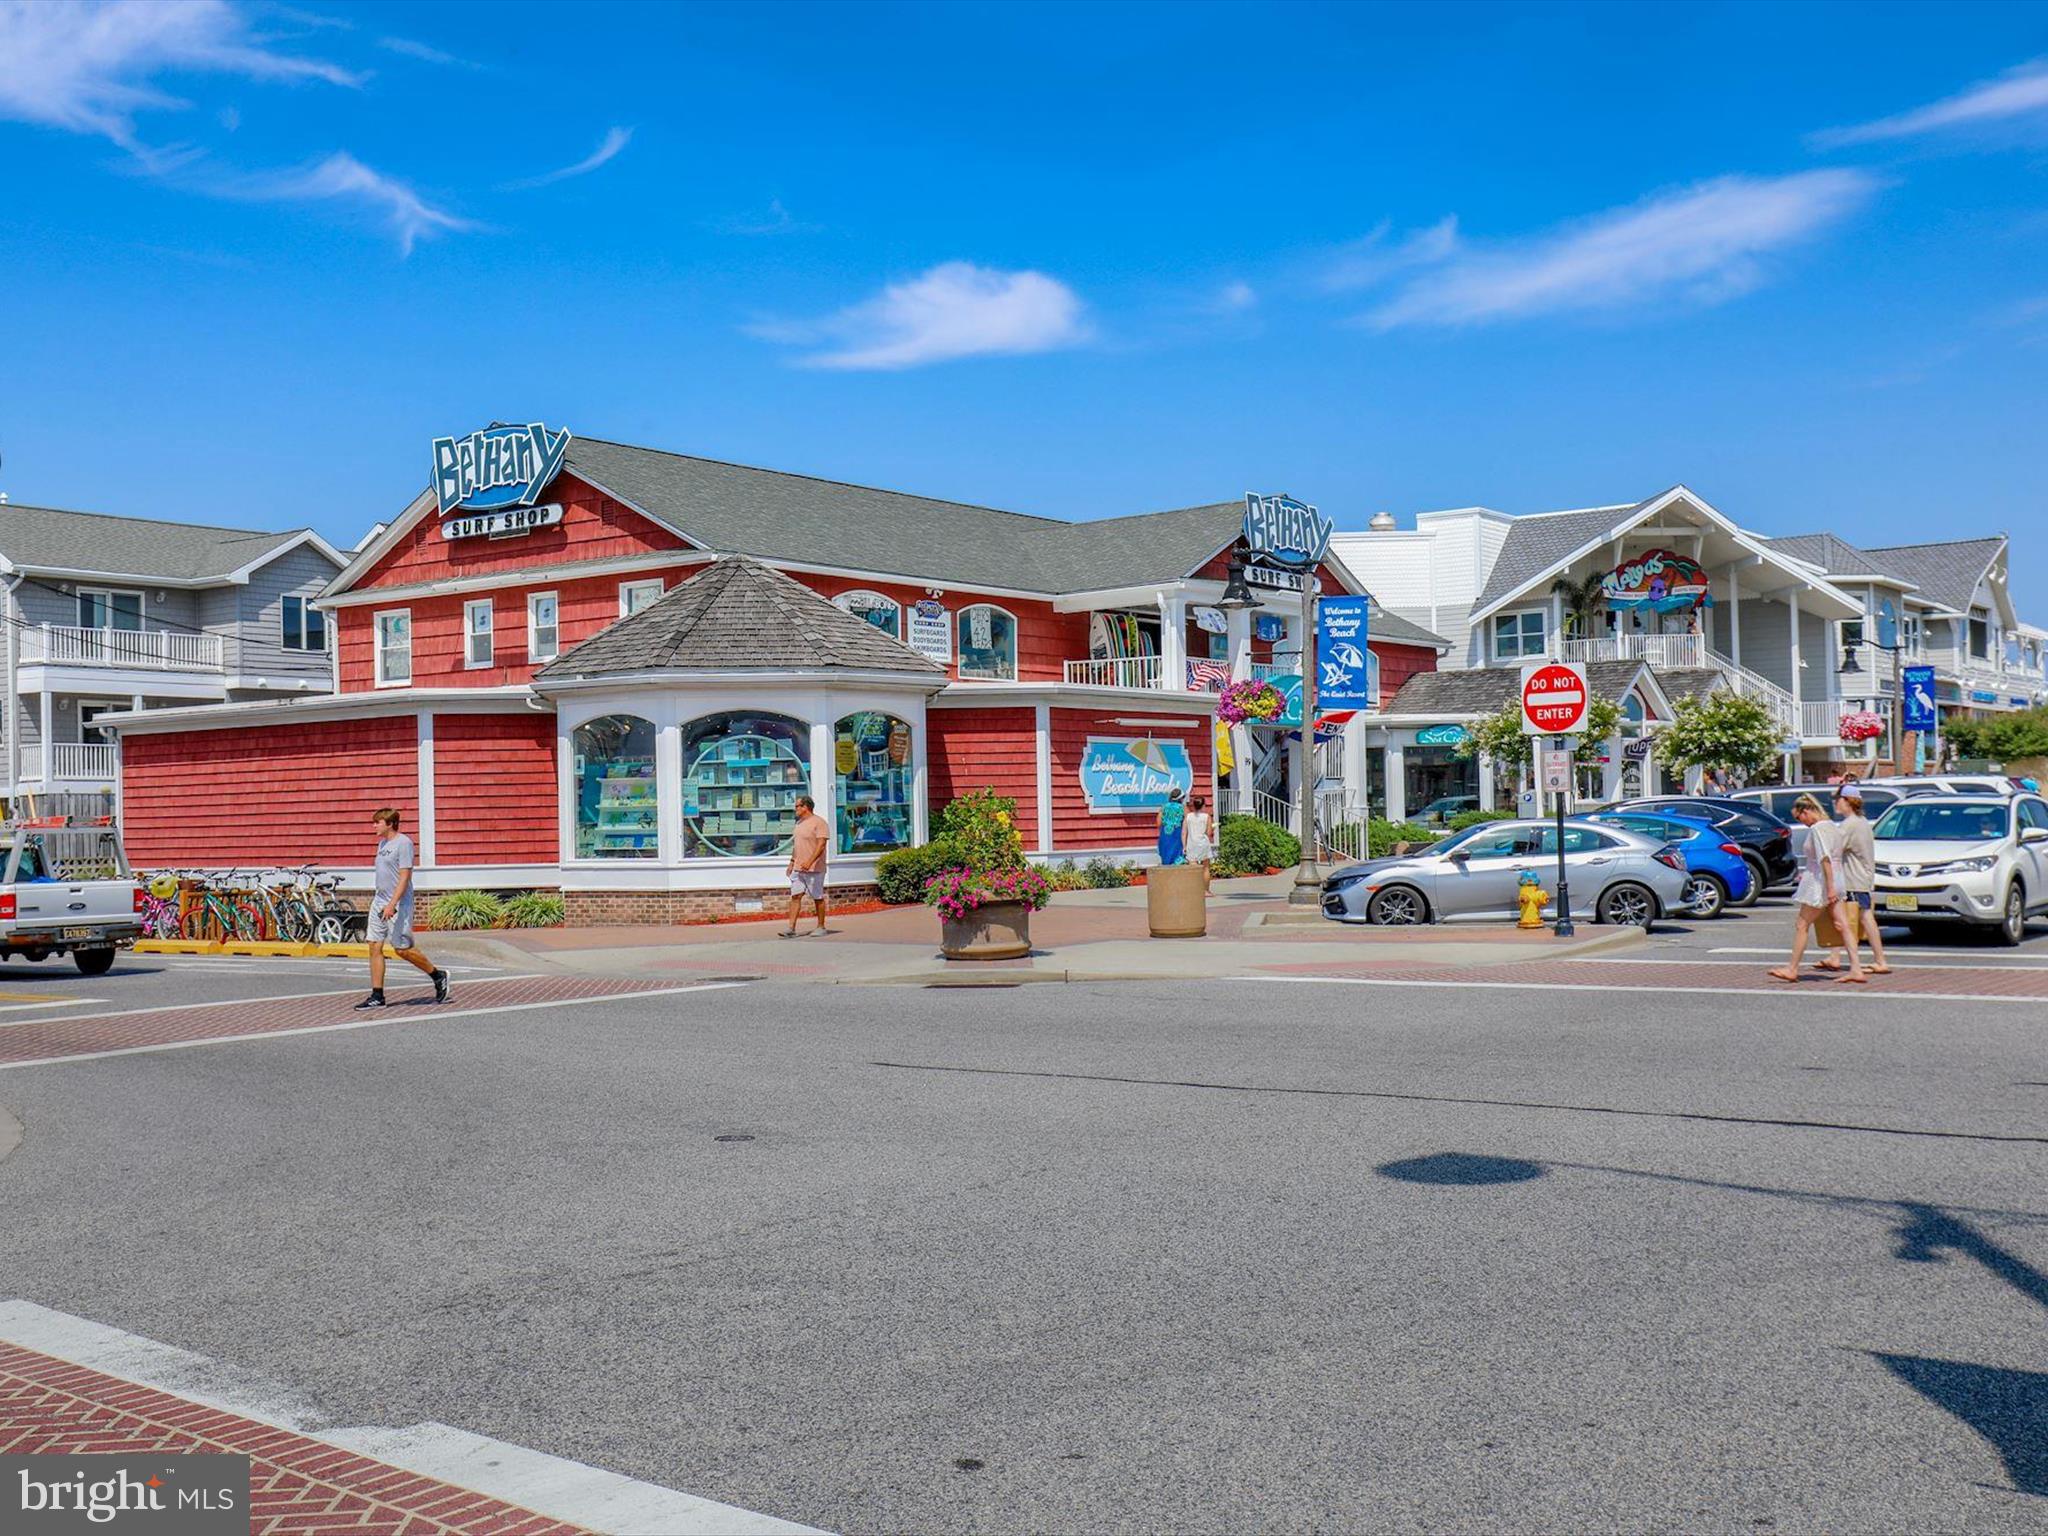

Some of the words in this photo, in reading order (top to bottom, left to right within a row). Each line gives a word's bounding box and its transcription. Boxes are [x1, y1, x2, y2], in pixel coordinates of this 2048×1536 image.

[451, 516, 496, 537] SURF
[504, 508, 550, 528] SHOP
[1252, 568, 1281, 585] SURF
[1324, 607, 1353, 615] Welcome
[1325, 617, 1360, 629] Bethany
[1329, 628, 1356, 638] Beach
[1531, 679, 1547, 690] DO
[1553, 676, 1576, 689] NOT
[1536, 708, 1573, 720] ENTER
[1092, 754, 1136, 778] Bethany
[1101, 774, 1140, 795] Beach
